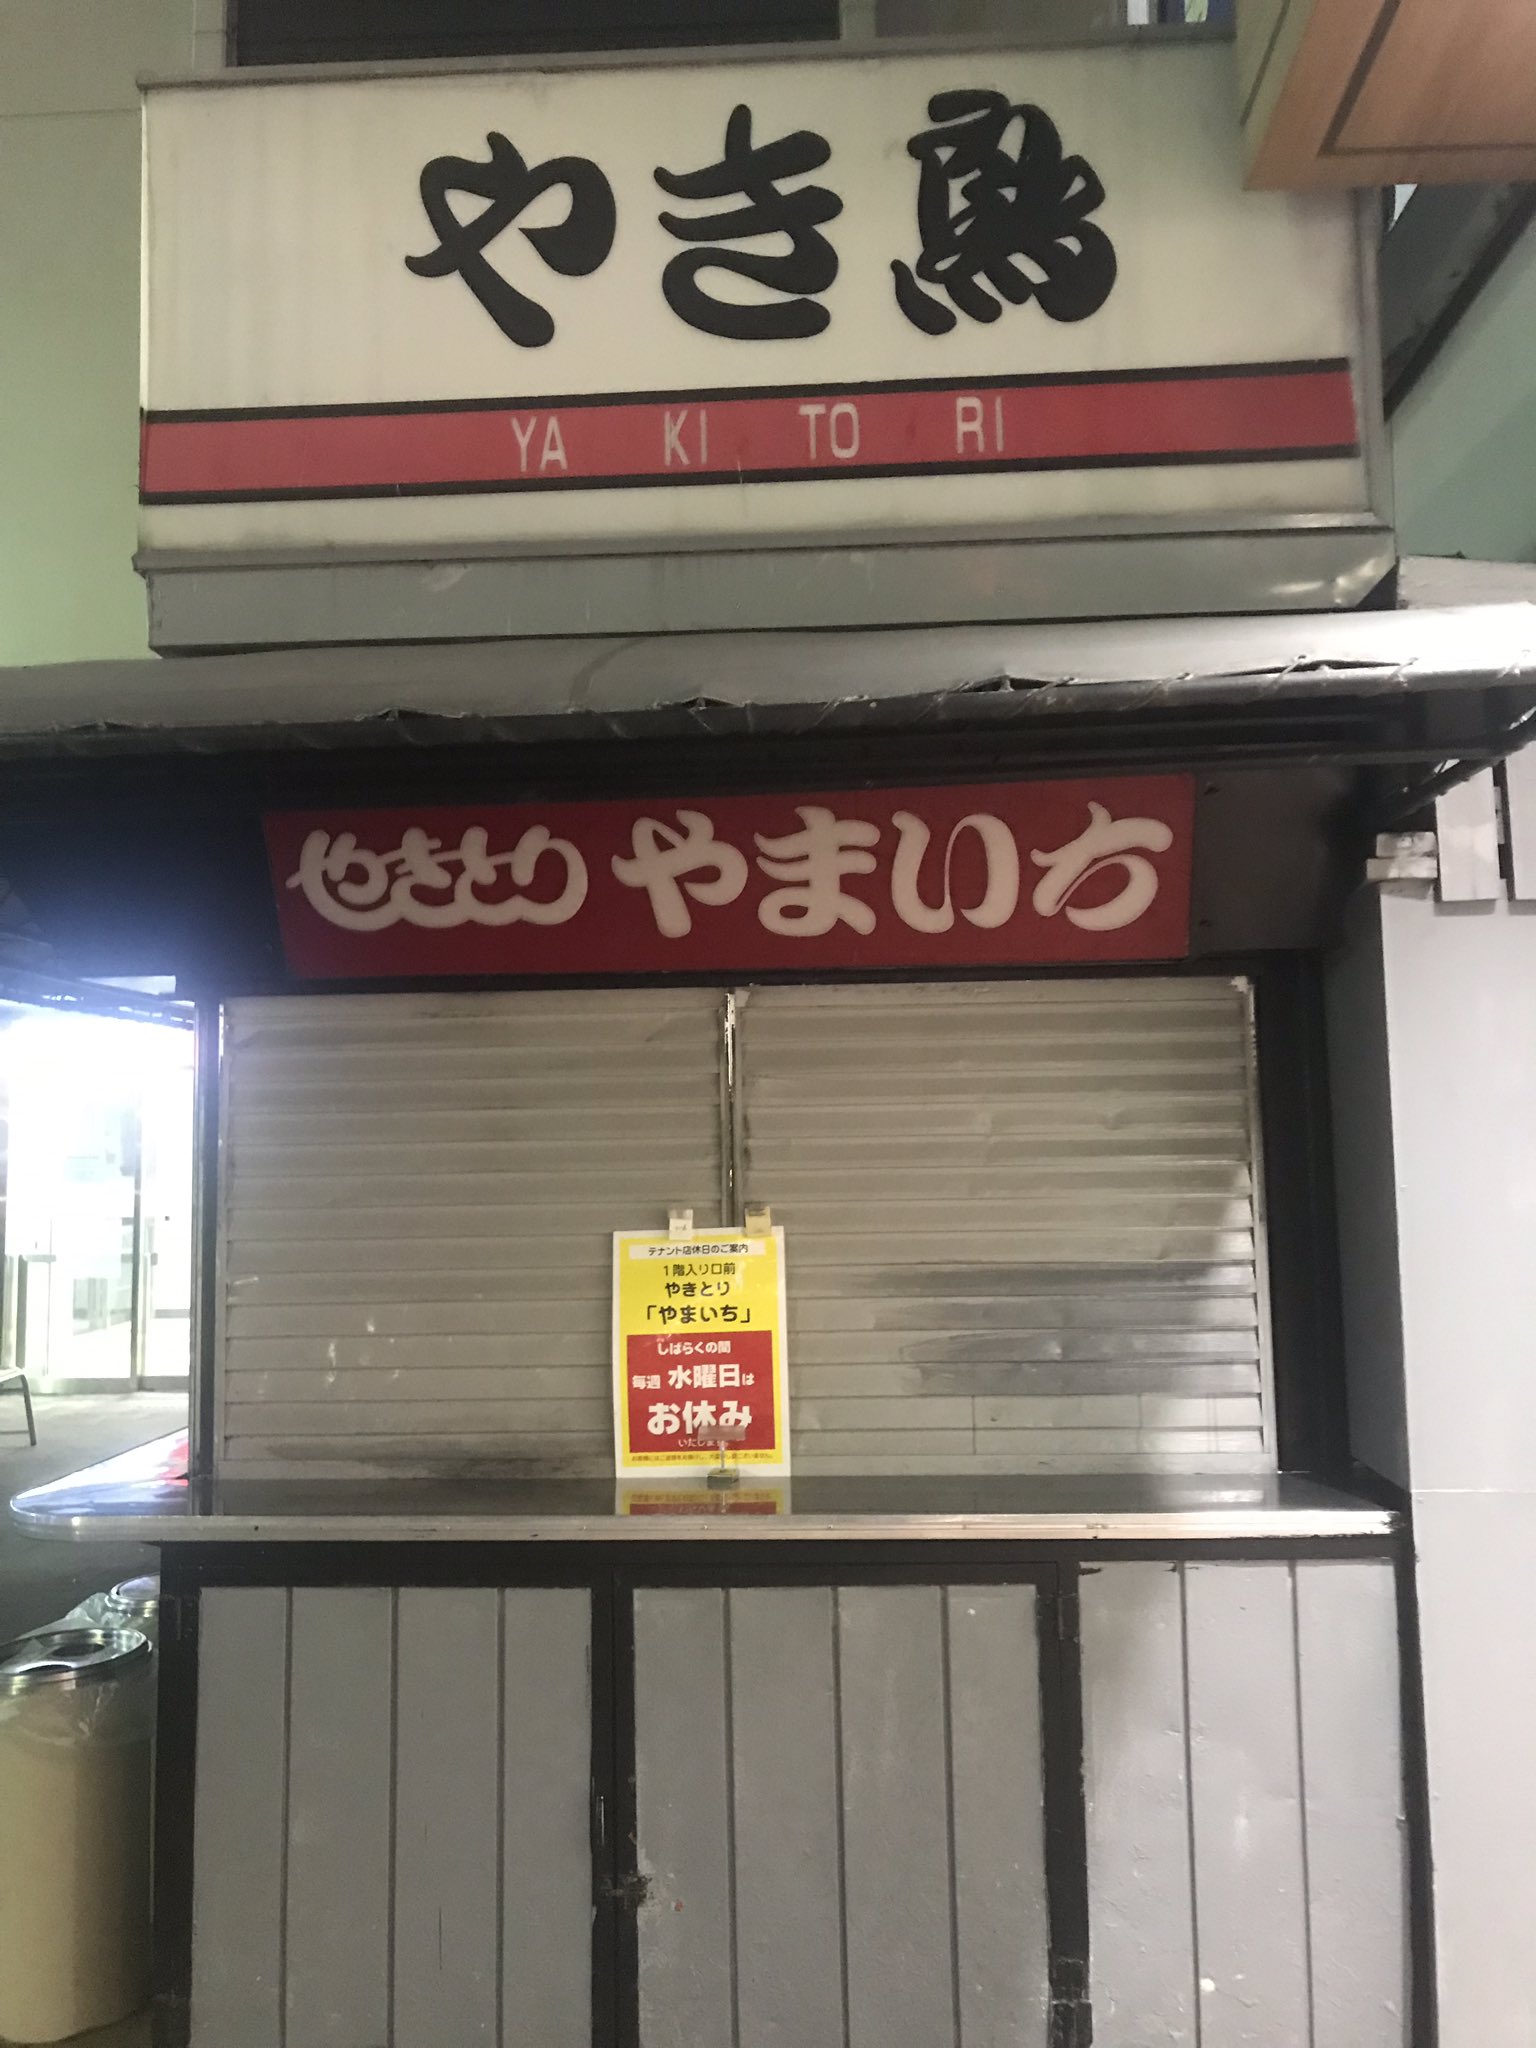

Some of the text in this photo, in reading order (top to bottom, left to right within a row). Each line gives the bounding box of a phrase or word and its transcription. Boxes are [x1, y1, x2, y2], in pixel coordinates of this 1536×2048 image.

[405, 89, 1117, 347] やき鳥
[511, 396, 1004, 472] YA KI TO RI
[285, 801, 1174, 938] やきとり やまいち
[648, 1243, 749, 1257] テナント店休日のご案内
[664, 1281, 731, 1297] やきとり
[646, 1304, 751, 1325] 「やまいち」
[657, 1341, 731, 1355] しばらくの間
[647, 1400, 752, 1435] お休み
